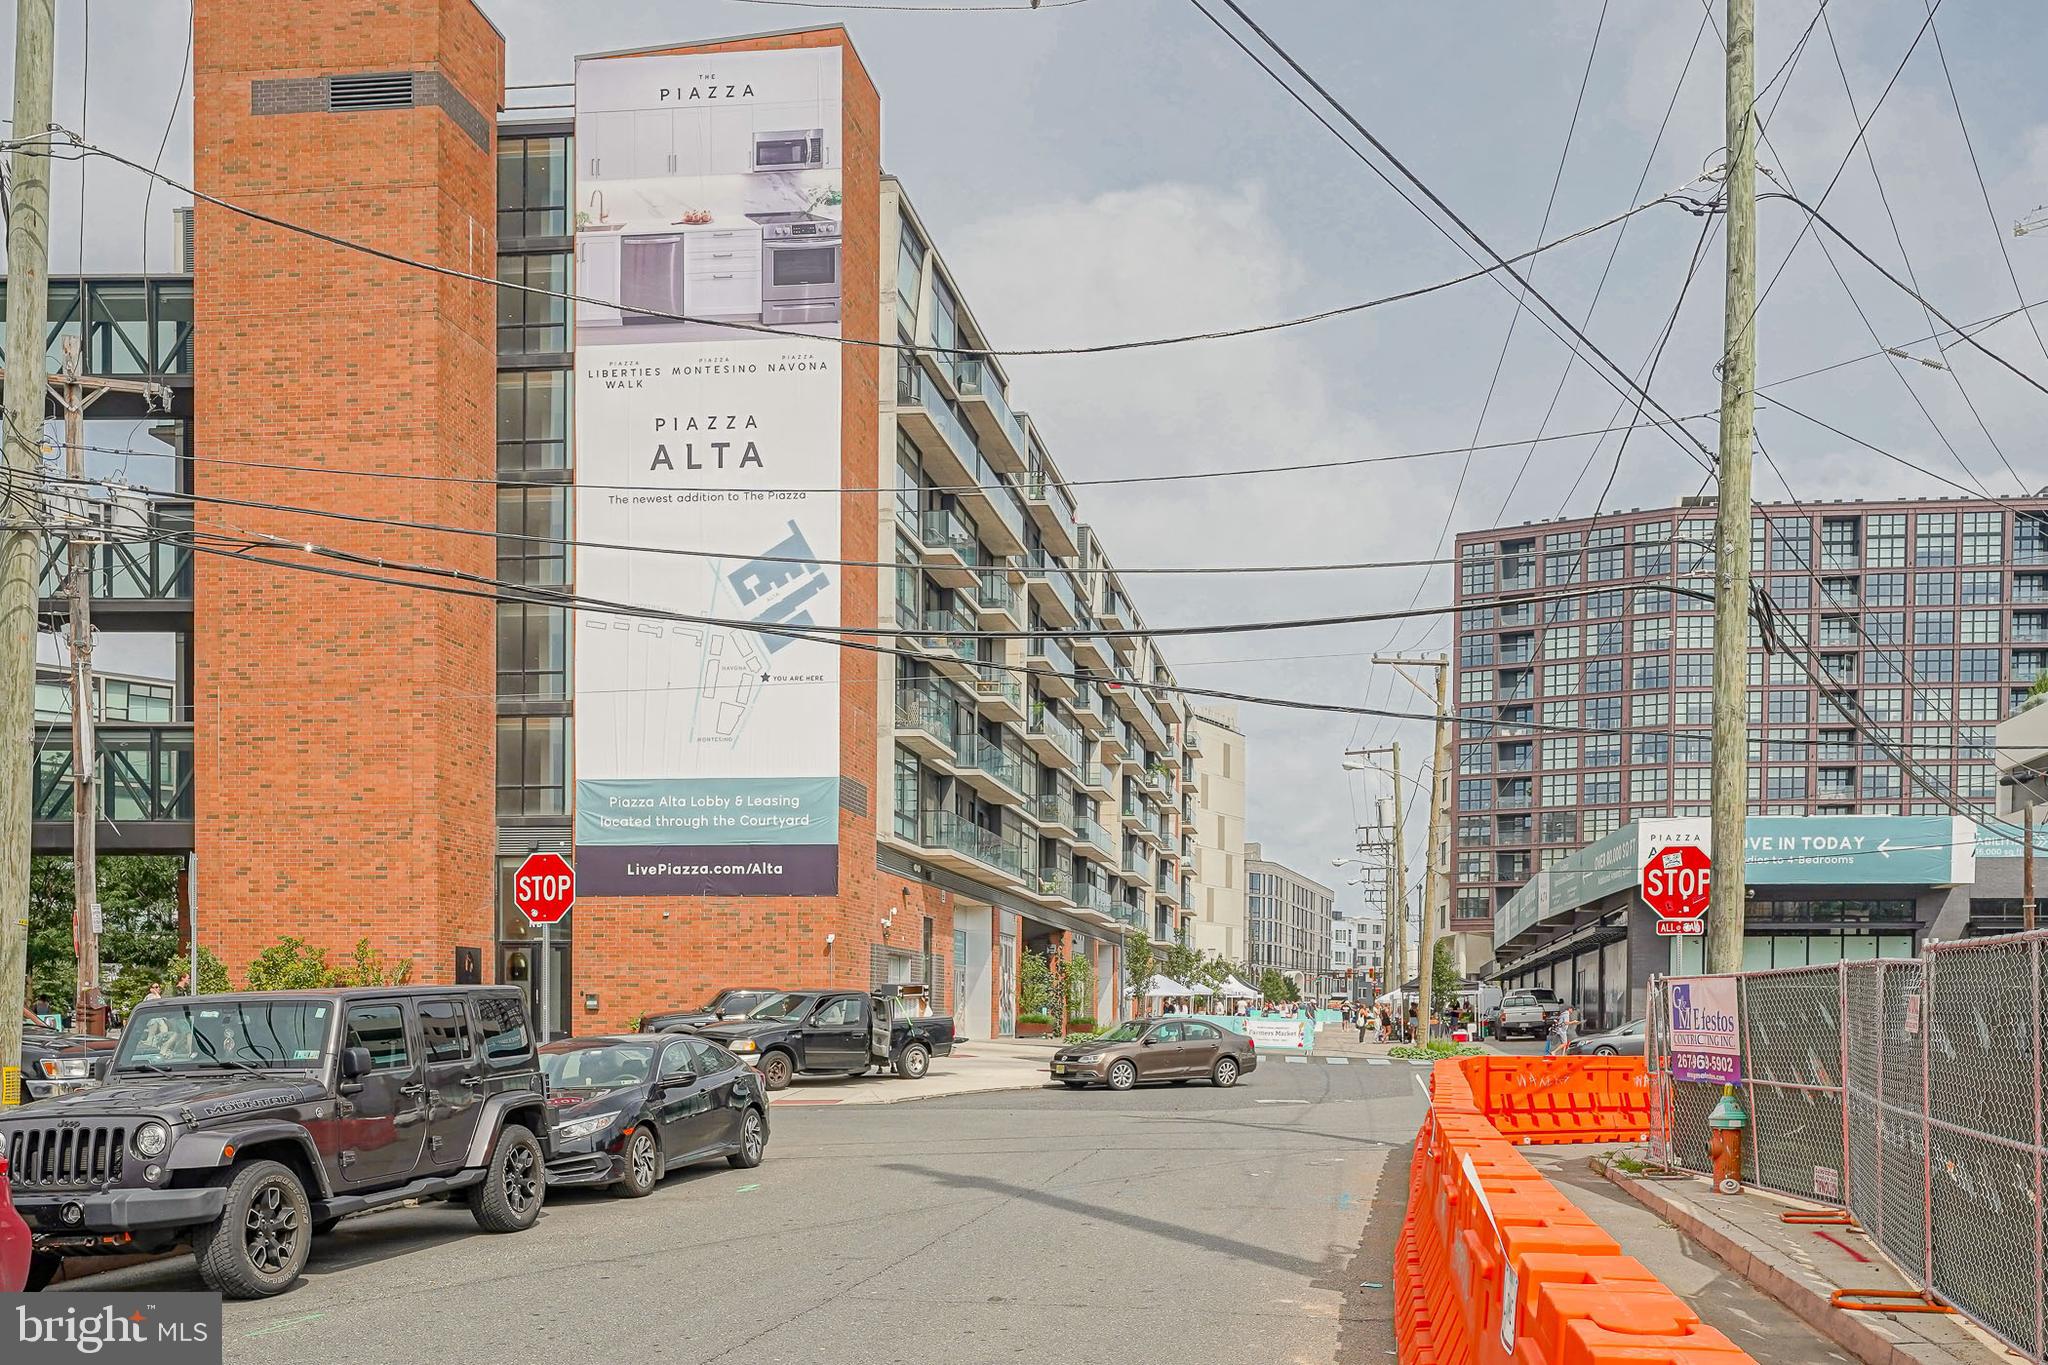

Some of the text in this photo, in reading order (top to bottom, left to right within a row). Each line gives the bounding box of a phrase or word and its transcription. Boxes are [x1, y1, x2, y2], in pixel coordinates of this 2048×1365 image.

[659, 84, 755, 101] PIAZZA
[588, 367, 661, 379] LIBERTIES
[672, 364, 757, 376] MONTESINO
[767, 361, 828, 373] NAVONA
[605, 380, 643, 389] WALK
[655, 415, 758, 432] PIAZZA
[650, 441, 764, 471] ALTA
[608, 490, 806, 505] The newest addition to The Piazza
[609, 794, 800, 811] Piazza Alta Lobby & Leasing
[600, 813, 810, 829] located through the Courtyard
[1650, 833, 1701, 842] PIAZZA
[1778, 836, 1795, 850] IN
[1801, 836, 1865, 850] TODAY
[1772, 855, 1785, 865] to
[627, 862, 784, 876] LivePiazza.com/Alta
[518, 875, 571, 902] STOP
[1647, 868, 1710, 896] STOP
[1661, 923, 1676, 933] ALL
[1720, 1035, 1736, 1048] INC.
[204, 1094, 297, 1117] MOUNTAIN
[57, 1119, 81, 1130] Jeep
